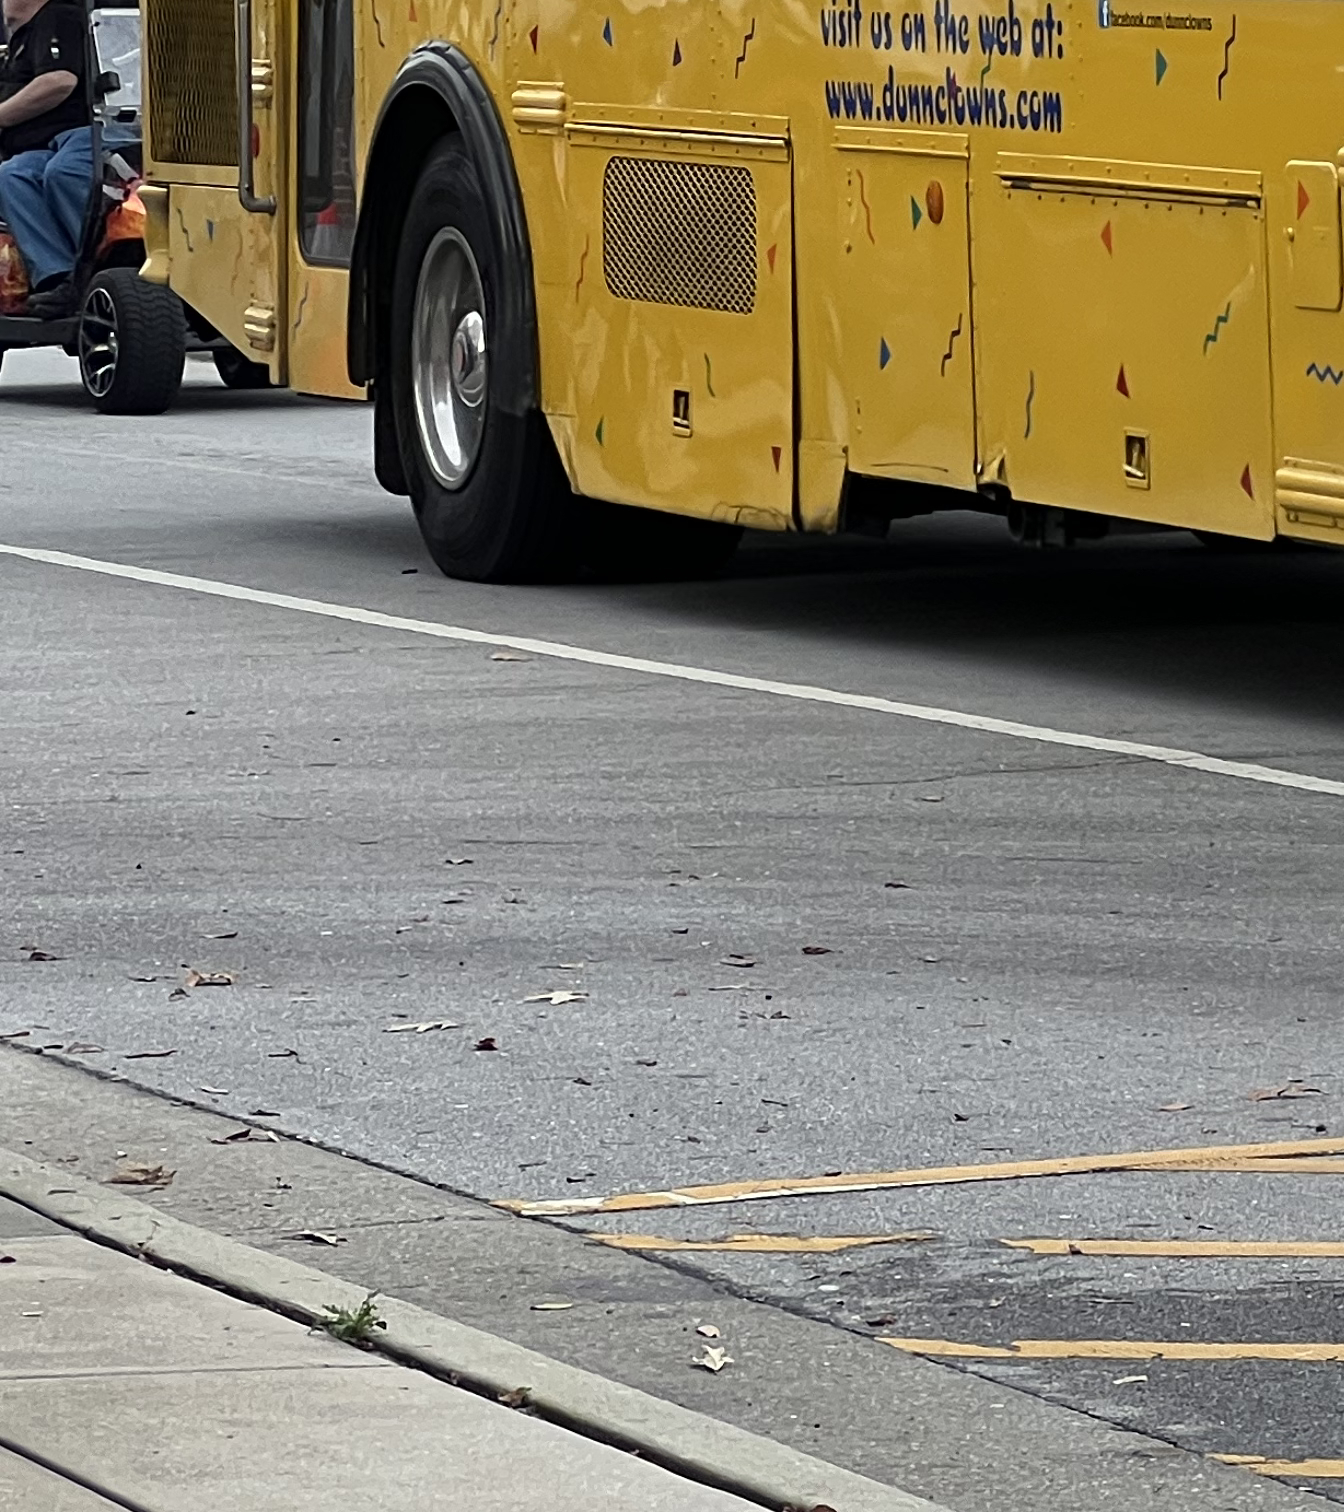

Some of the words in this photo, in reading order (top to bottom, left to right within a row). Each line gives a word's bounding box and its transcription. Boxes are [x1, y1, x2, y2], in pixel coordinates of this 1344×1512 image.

[871, 11, 893, 51] us
[901, 12, 927, 54] on
[1032, 2, 1064, 60] at:
[825, 64, 1063, 134] www.dunnclowns.com
